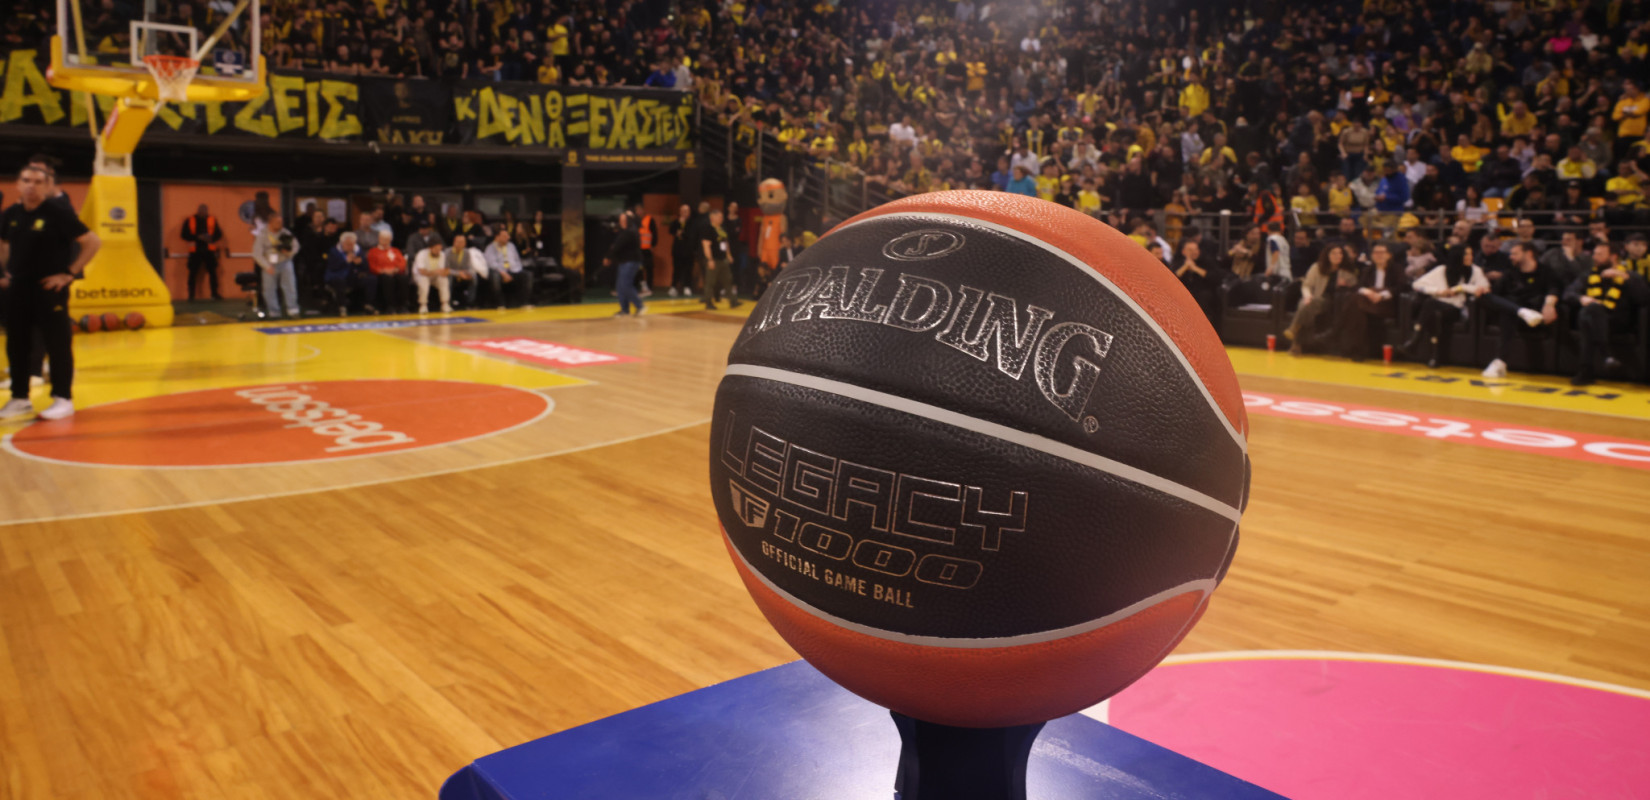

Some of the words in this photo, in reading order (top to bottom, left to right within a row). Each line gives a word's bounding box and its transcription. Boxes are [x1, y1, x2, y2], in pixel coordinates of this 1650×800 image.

[477, 86, 546, 146] ΔΕΝ
[745, 265, 1114, 422] PALDING
[720, 409, 1029, 552] LEGACY
[761, 540, 819, 581] OFFICIAL
[824, 569, 867, 596] GAME
[873, 582, 915, 609] BALL
[774, 508, 984, 590] 1000
